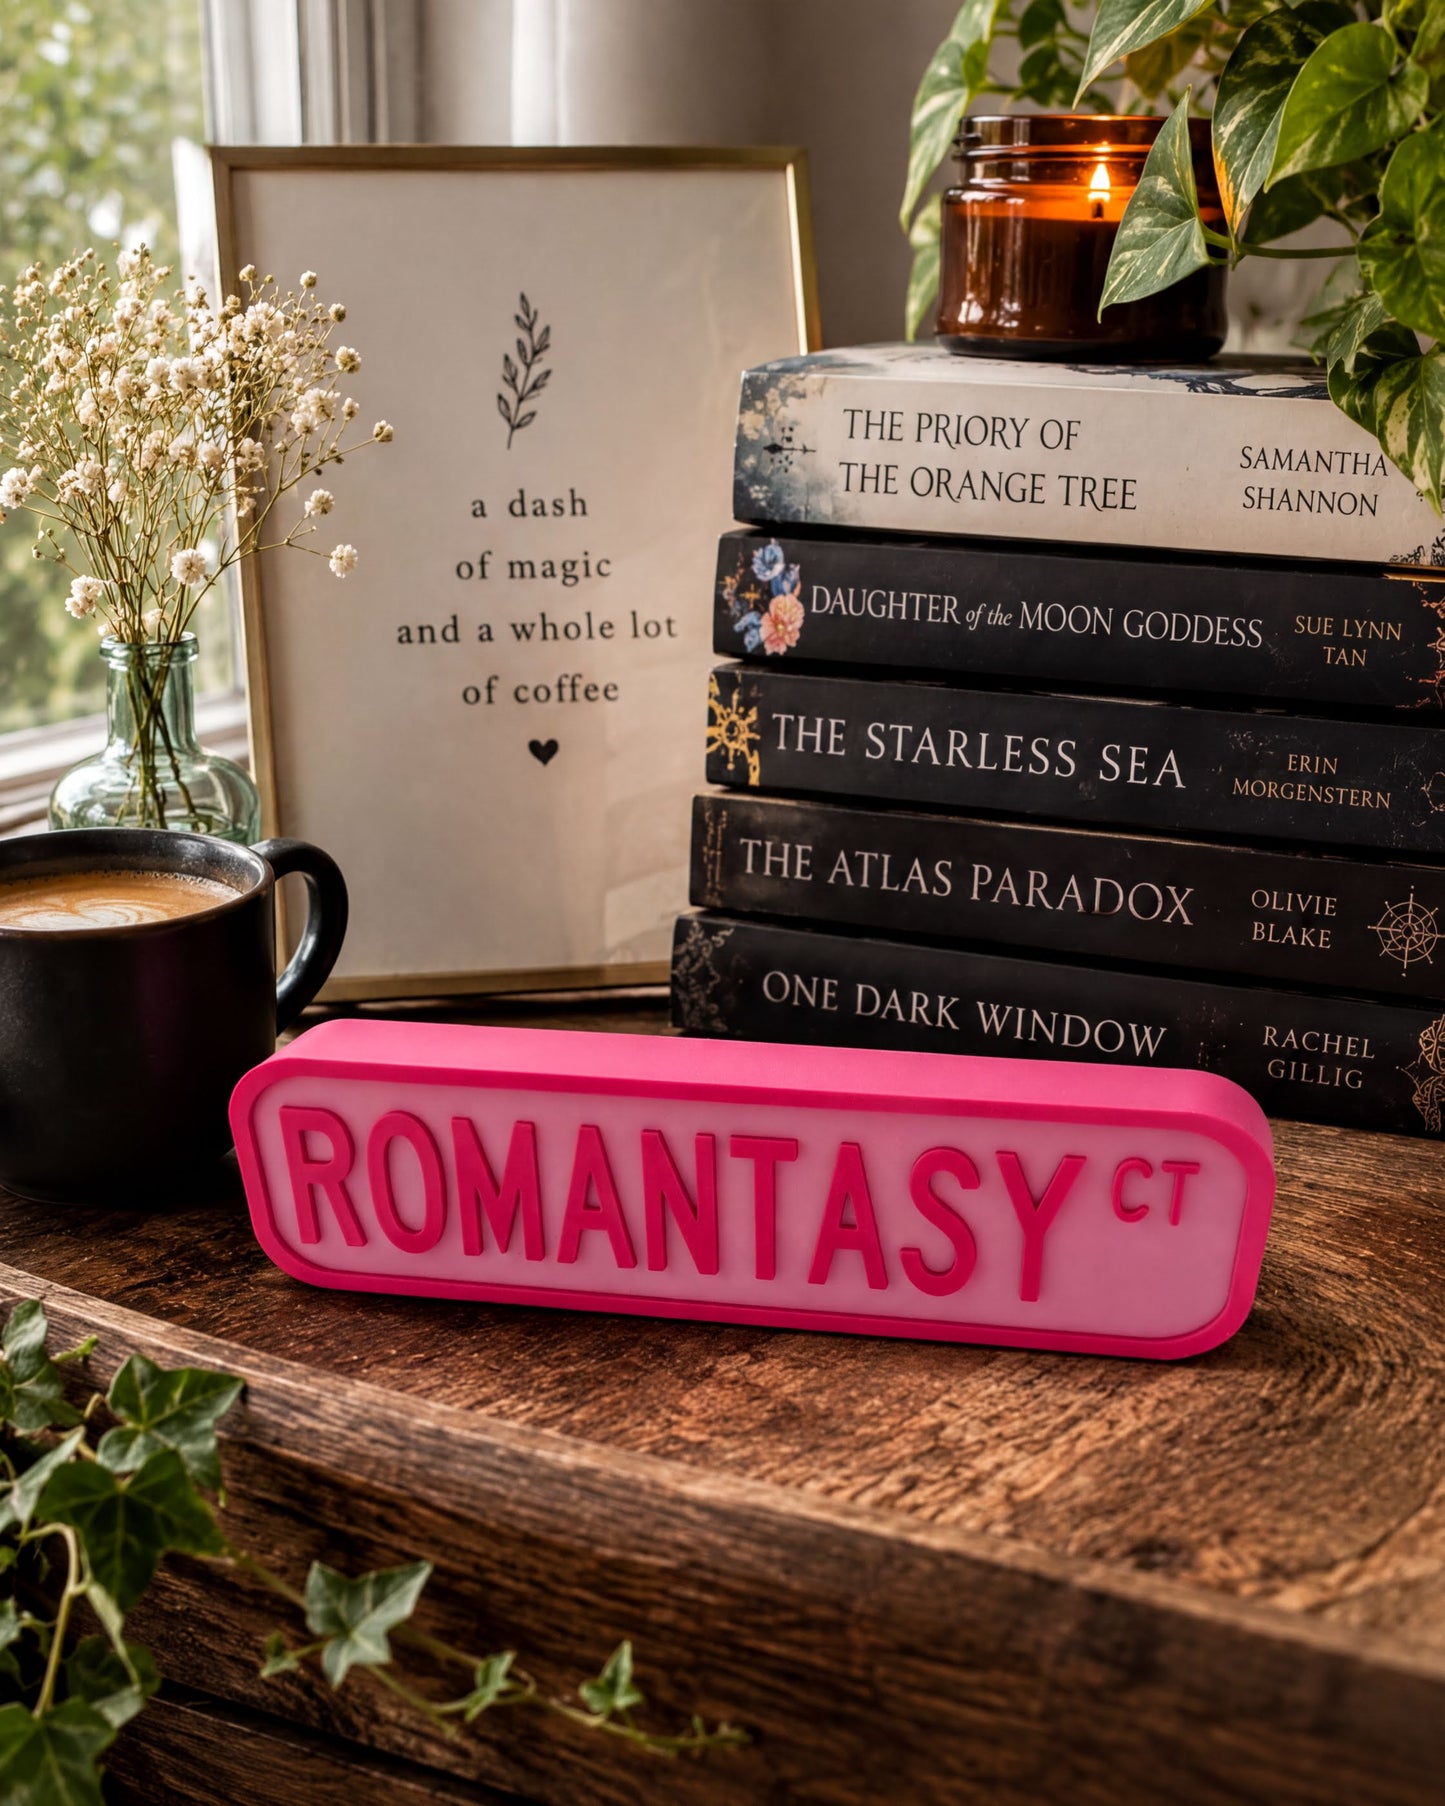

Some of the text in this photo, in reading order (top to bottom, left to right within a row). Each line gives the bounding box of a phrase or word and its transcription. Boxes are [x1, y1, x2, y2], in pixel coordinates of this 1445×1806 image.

[843, 408, 1081, 451] THE PRIORY OF
[1239, 443, 1389, 477] SAMANTHA
[471, 488, 587, 518] a dash
[838, 461, 1137, 512] THE ORANGE TREE
[1242, 485, 1379, 517] SHANNON
[455, 550, 611, 587] of magic
[397, 610, 677, 645] and a whole lot
[811, 585, 1263, 648] DAUGHTER of the MOON GODDESS
[1294, 615, 1402, 641] SUE LYNN
[1322, 646, 1367, 667] TAN
[462, 673, 618, 705] of coffee
[772, 713, 1186, 789] THE STARLESS SEA
[1287, 753, 1338, 775] ERIN
[1232, 777, 1391, 809] MORGENSTERN
[739, 838, 1194, 926] THE ATLAS PARADOX
[1251, 889, 1337, 917] OLIVIE
[1252, 921, 1331, 949] BLAKE
[762, 970, 1167, 1057] ONE DARK WINDOW
[1263, 1025, 1375, 1059] RACHEL
[1267, 1058, 1363, 1089] GILLIG
[279, 1106, 1202, 1302] ROMANTASY CT
